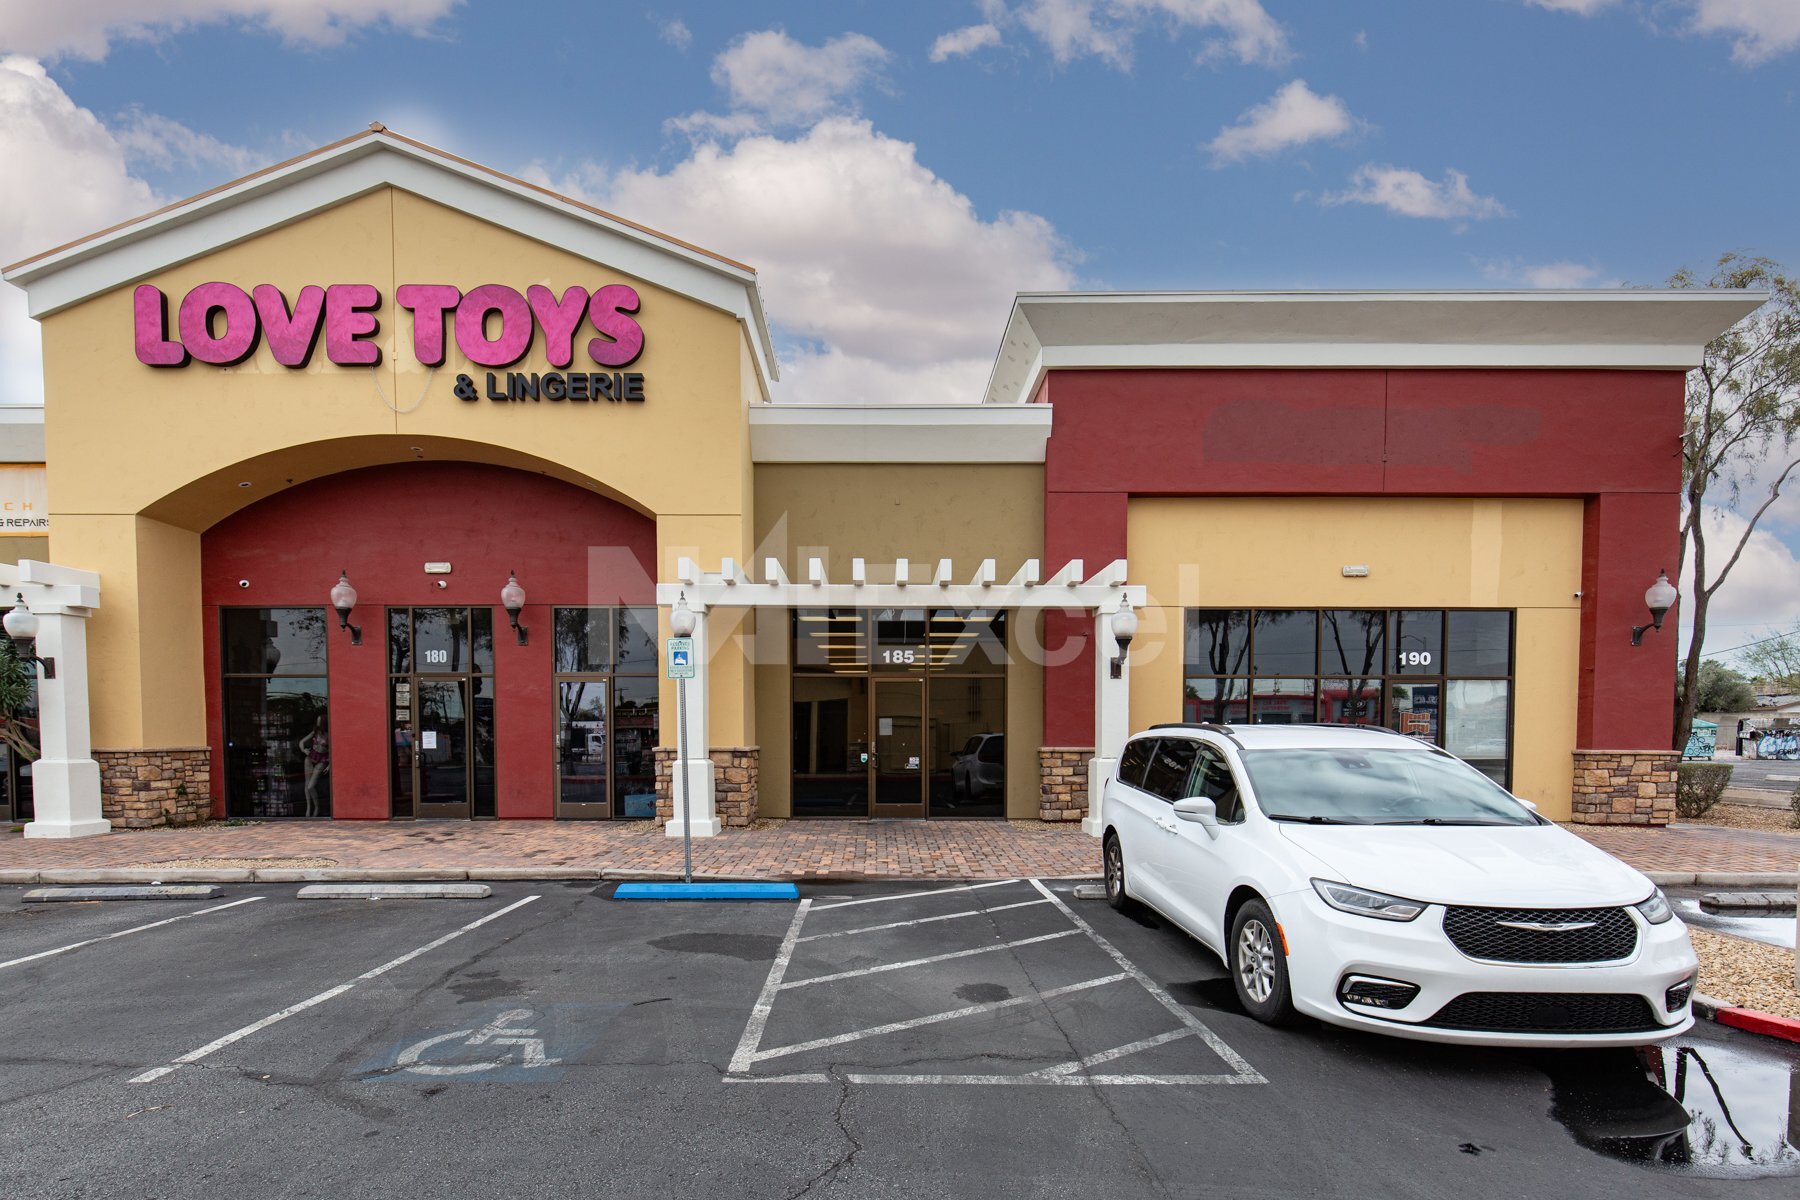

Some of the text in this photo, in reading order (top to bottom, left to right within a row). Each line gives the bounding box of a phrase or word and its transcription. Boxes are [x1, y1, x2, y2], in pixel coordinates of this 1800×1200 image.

[134, 282, 645, 370] LOVE TOYS
[453, 372, 646, 402] & LINGERIE
[6, 518, 49, 527] REPAIR
[424, 649, 447, 663] 180
[882, 649, 915, 664] 185
[1398, 651, 1432, 666] 190
